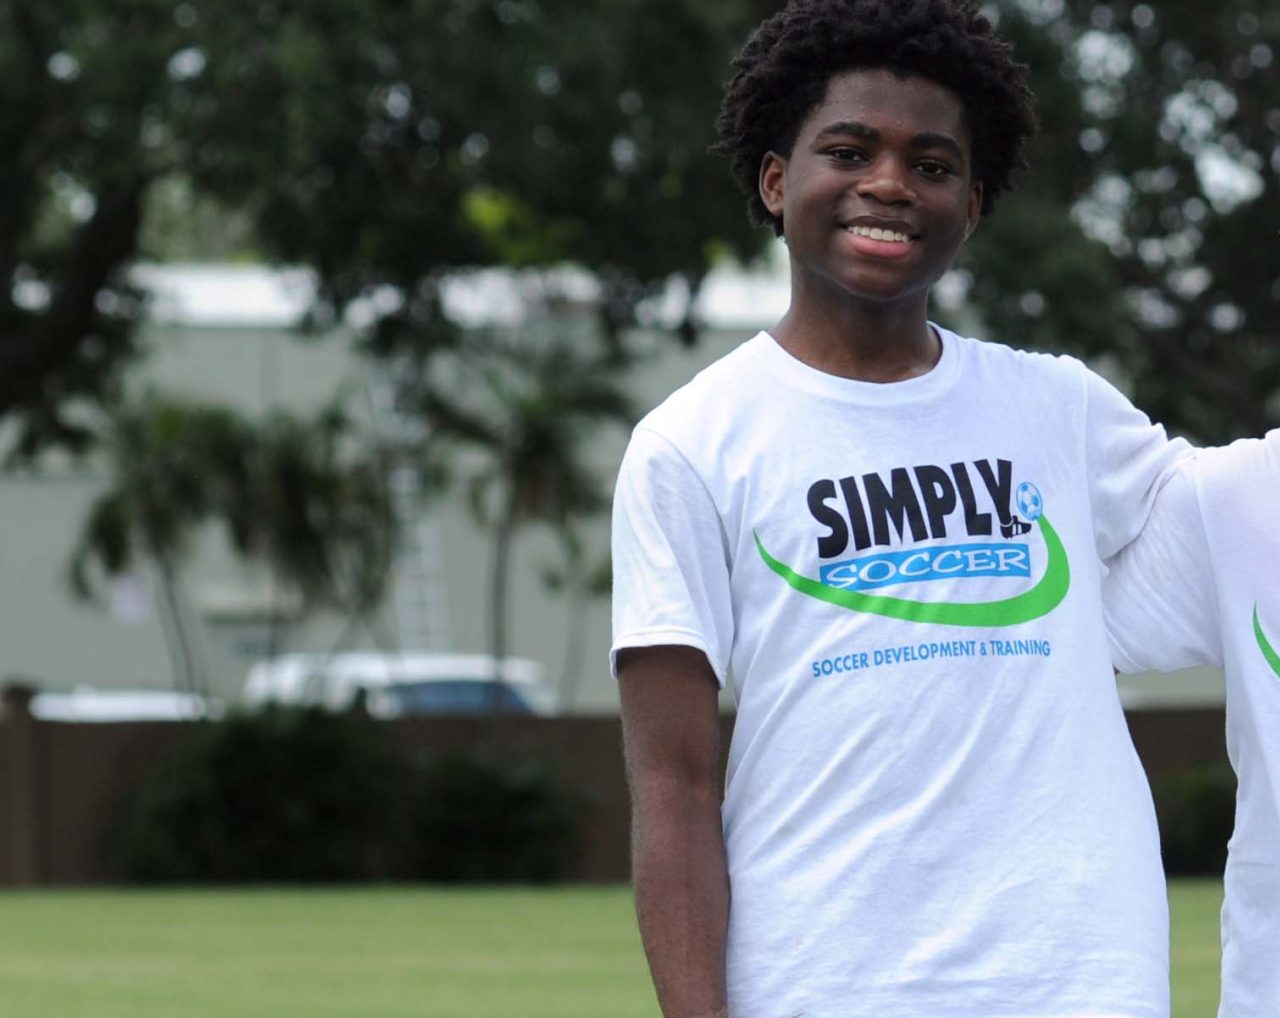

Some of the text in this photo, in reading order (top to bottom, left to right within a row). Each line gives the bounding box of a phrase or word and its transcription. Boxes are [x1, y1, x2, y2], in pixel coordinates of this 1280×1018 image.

[807, 459, 1014, 559] SIMPLY
[825, 548, 1029, 589] SOCCER
[812, 640, 1051, 677] SOCCER DEVELOPMENT & TRAINING
